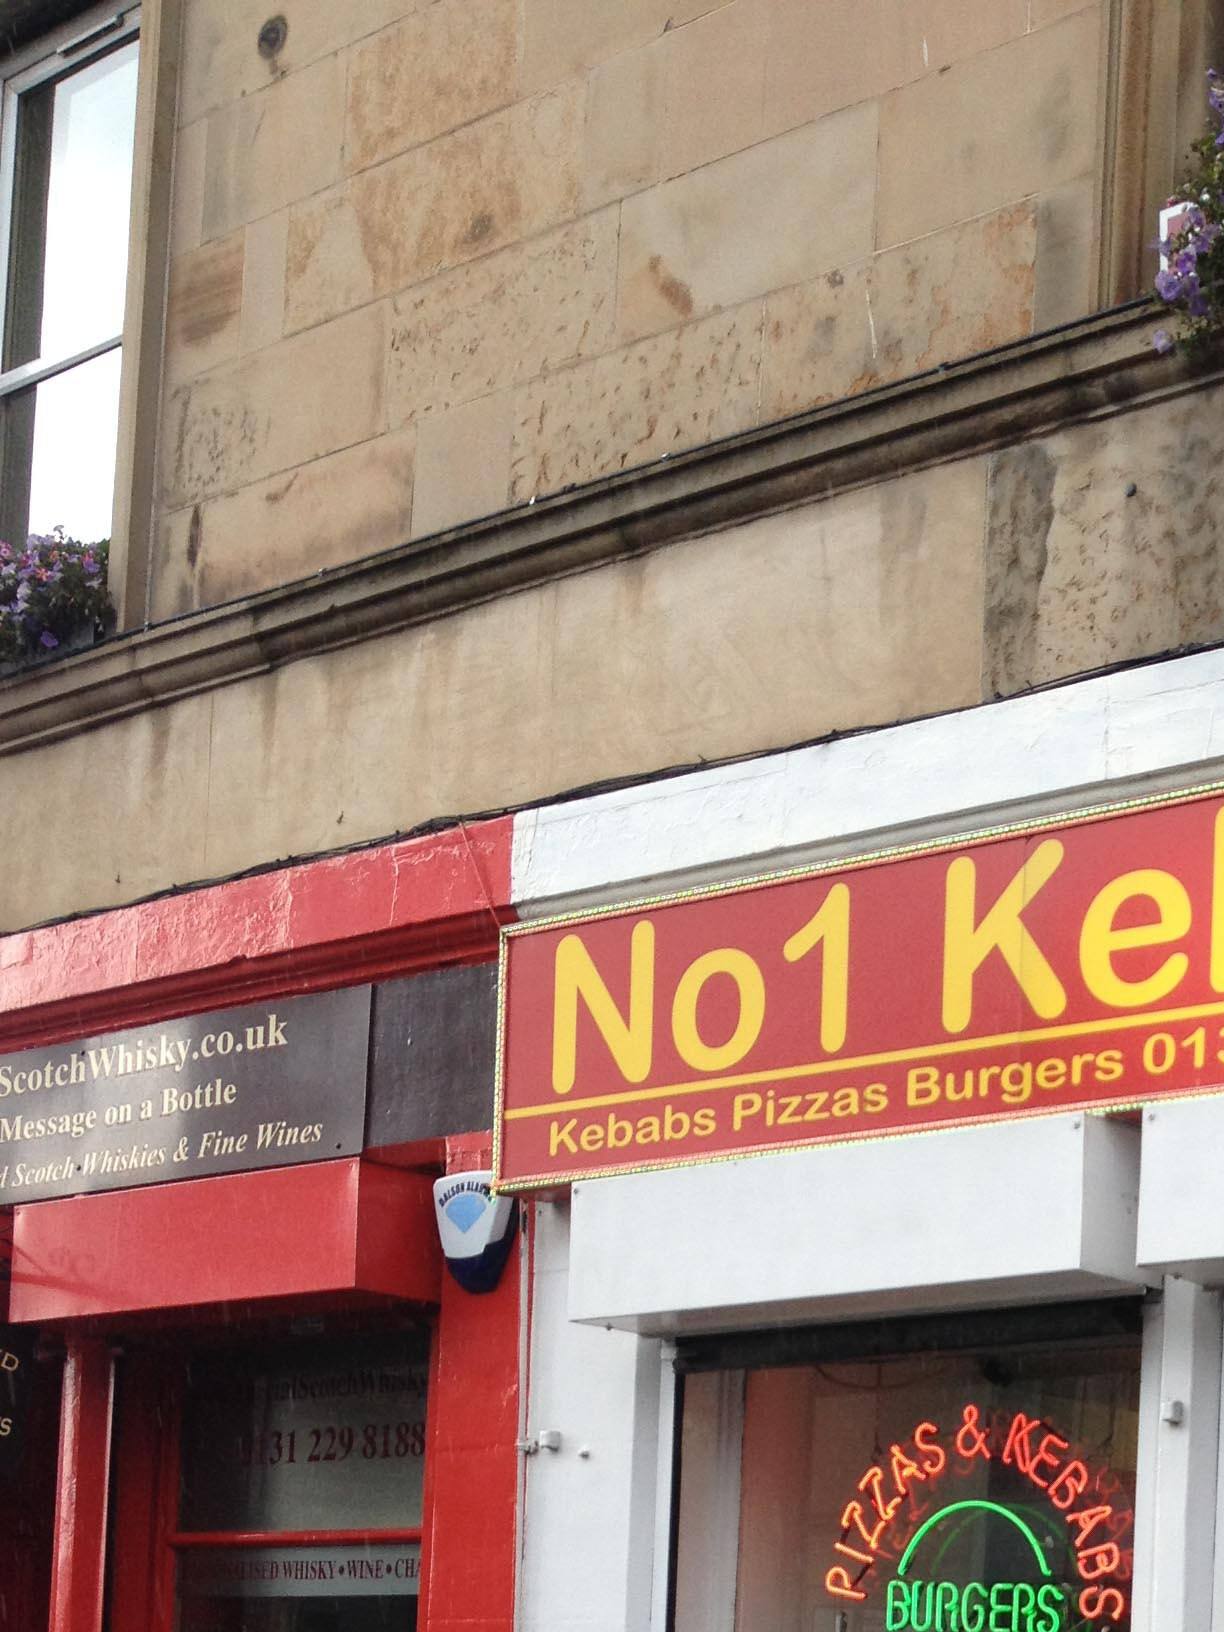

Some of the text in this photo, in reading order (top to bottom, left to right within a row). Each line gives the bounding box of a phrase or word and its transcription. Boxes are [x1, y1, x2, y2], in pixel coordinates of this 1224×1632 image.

[552, 883, 851, 1095] No1
[0, 1078, 237, 1144] Message on a Bottle
[549, 1105, 717, 1156] Kebabs
[732, 1082, 889, 1131] Pizzas
[906, 1048, 1124, 1107] Burgers
[12, 1156, 76, 1188] Scotch
[82, 1144, 167, 1176] Whiskies
[173, 1136, 190, 1163] &
[197, 1131, 247, 1159] Fine
[256, 1121, 324, 1150] Wines
[309, 1427, 354, 1462] 229
[364, 1422, 425, 1460] 8188
[825, 1404, 1126, 1625] PIZZAS & KEBABS
[282, 1558, 337, 1580] WHISKY
[347, 1557, 385, 1580] WINE
